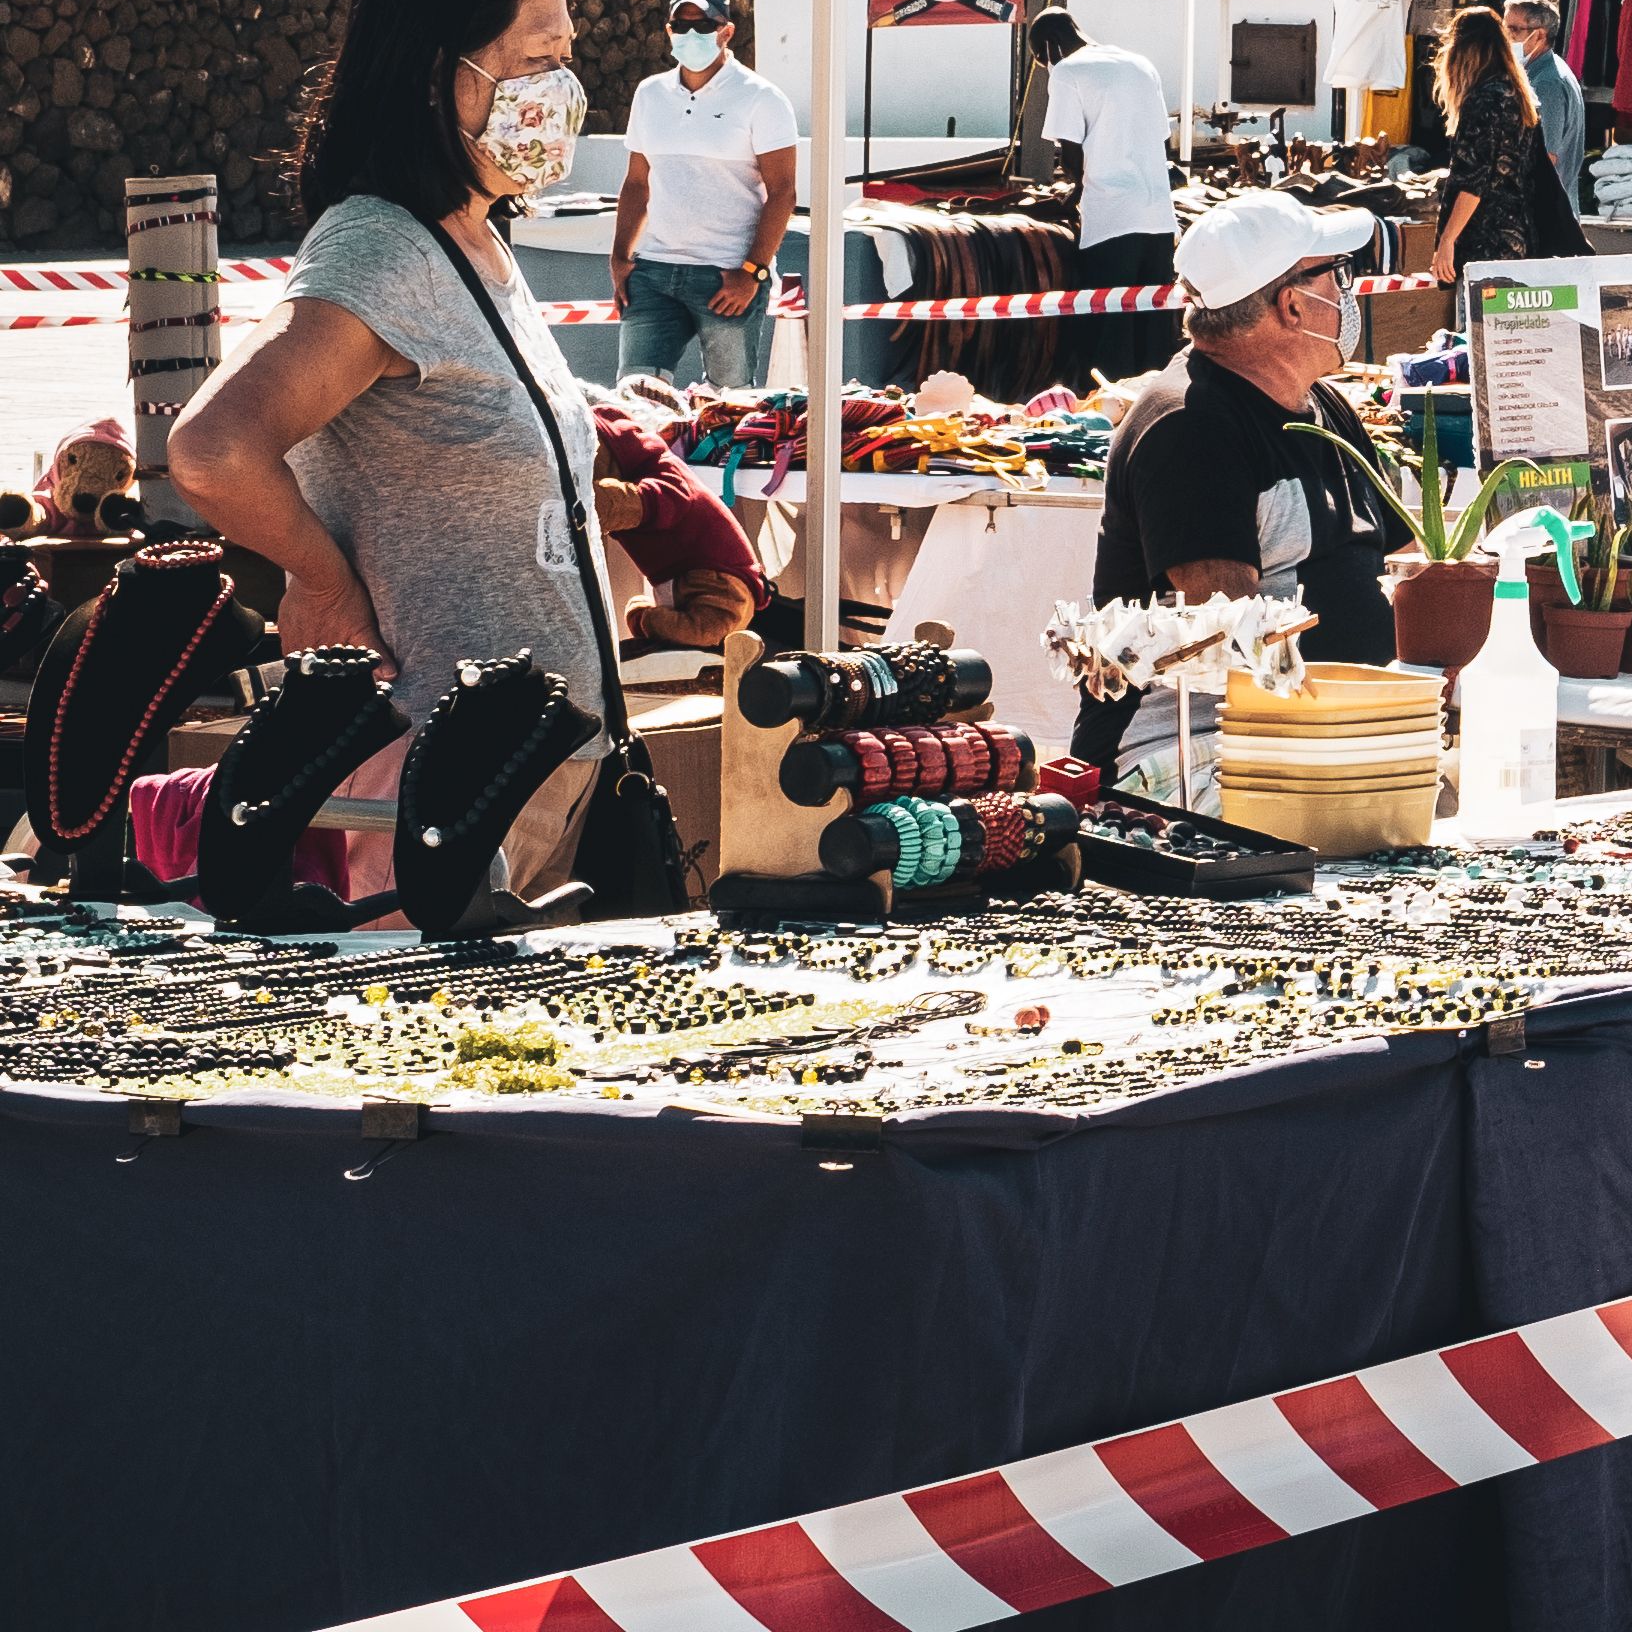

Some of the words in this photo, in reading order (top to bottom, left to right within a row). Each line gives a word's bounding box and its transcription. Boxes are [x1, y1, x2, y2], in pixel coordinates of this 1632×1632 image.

[1507, 290, 1553, 310] SALUD
[1494, 314, 1551, 334] Propiedades
[1519, 467, 1573, 488] HEALTH
